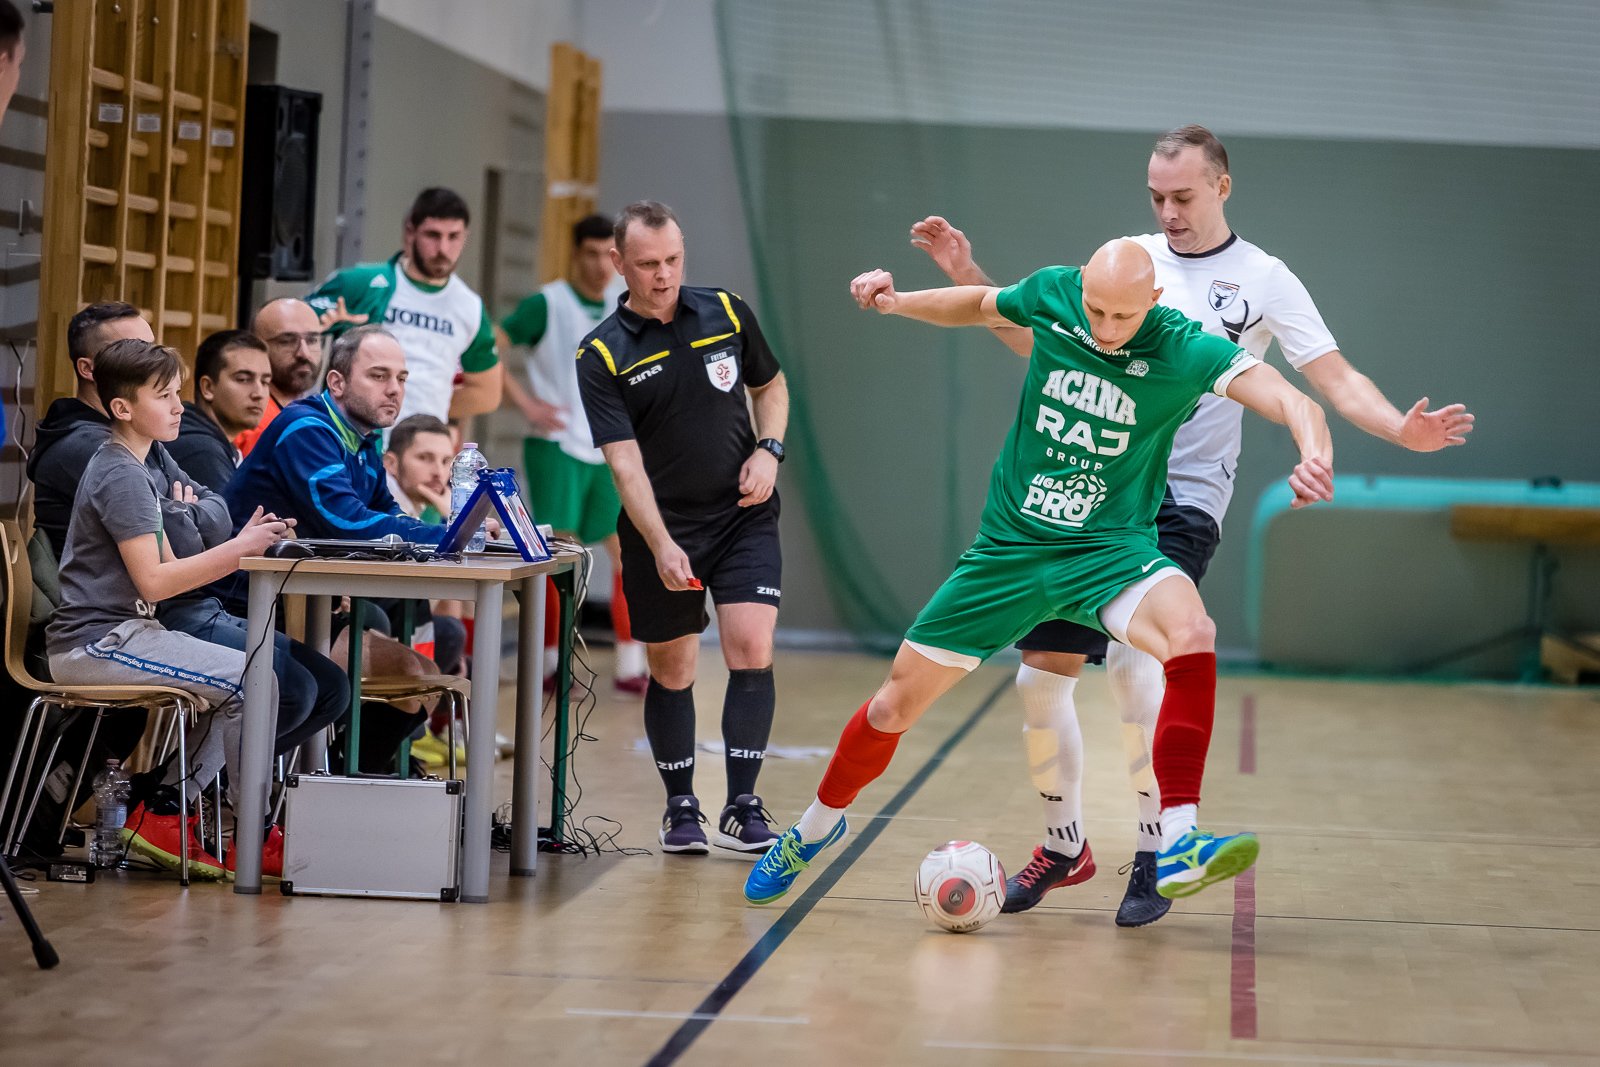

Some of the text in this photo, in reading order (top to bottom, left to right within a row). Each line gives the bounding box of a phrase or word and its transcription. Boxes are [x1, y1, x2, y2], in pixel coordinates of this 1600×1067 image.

[1041, 369, 1137, 425] ACANA
[1035, 404, 1130, 457] RAJ
[1046, 447, 1103, 471] GROUP
[1031, 473, 1064, 491] LIGA
[1022, 485, 1092, 522] PRO
[112, 653, 143, 669] PlayStation
[144, 662, 176, 676] PlayStation
